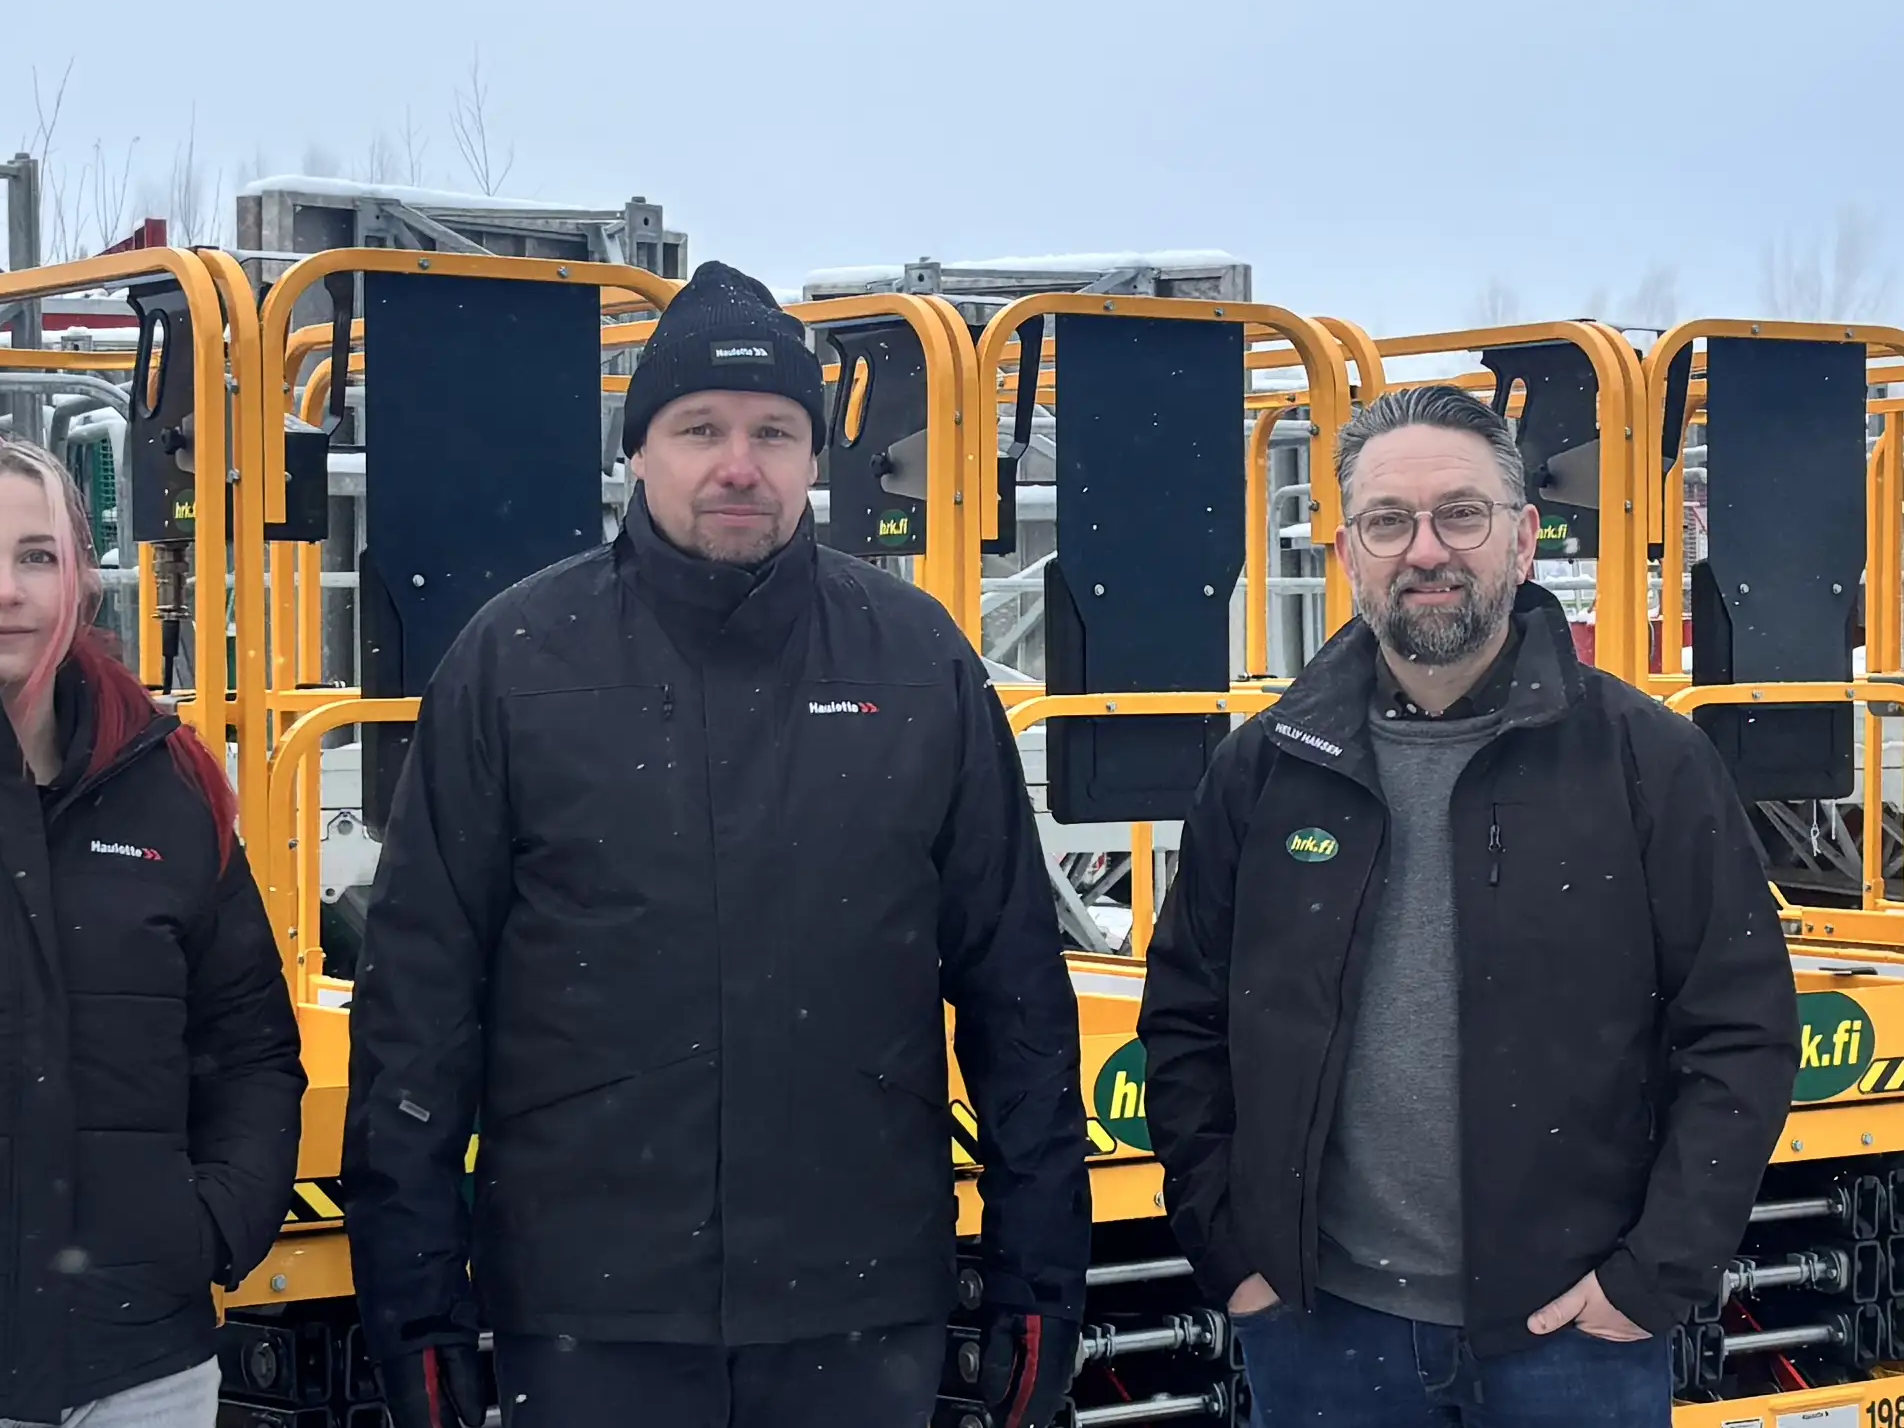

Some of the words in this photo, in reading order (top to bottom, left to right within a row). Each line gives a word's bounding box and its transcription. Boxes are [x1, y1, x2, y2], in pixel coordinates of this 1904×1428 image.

[1275, 722, 1302, 740] HELLY
[1301, 734, 1344, 757] HANSEN
[1290, 834, 1337, 856] hrk.fi
[1799, 1019, 1863, 1069] k.fi
